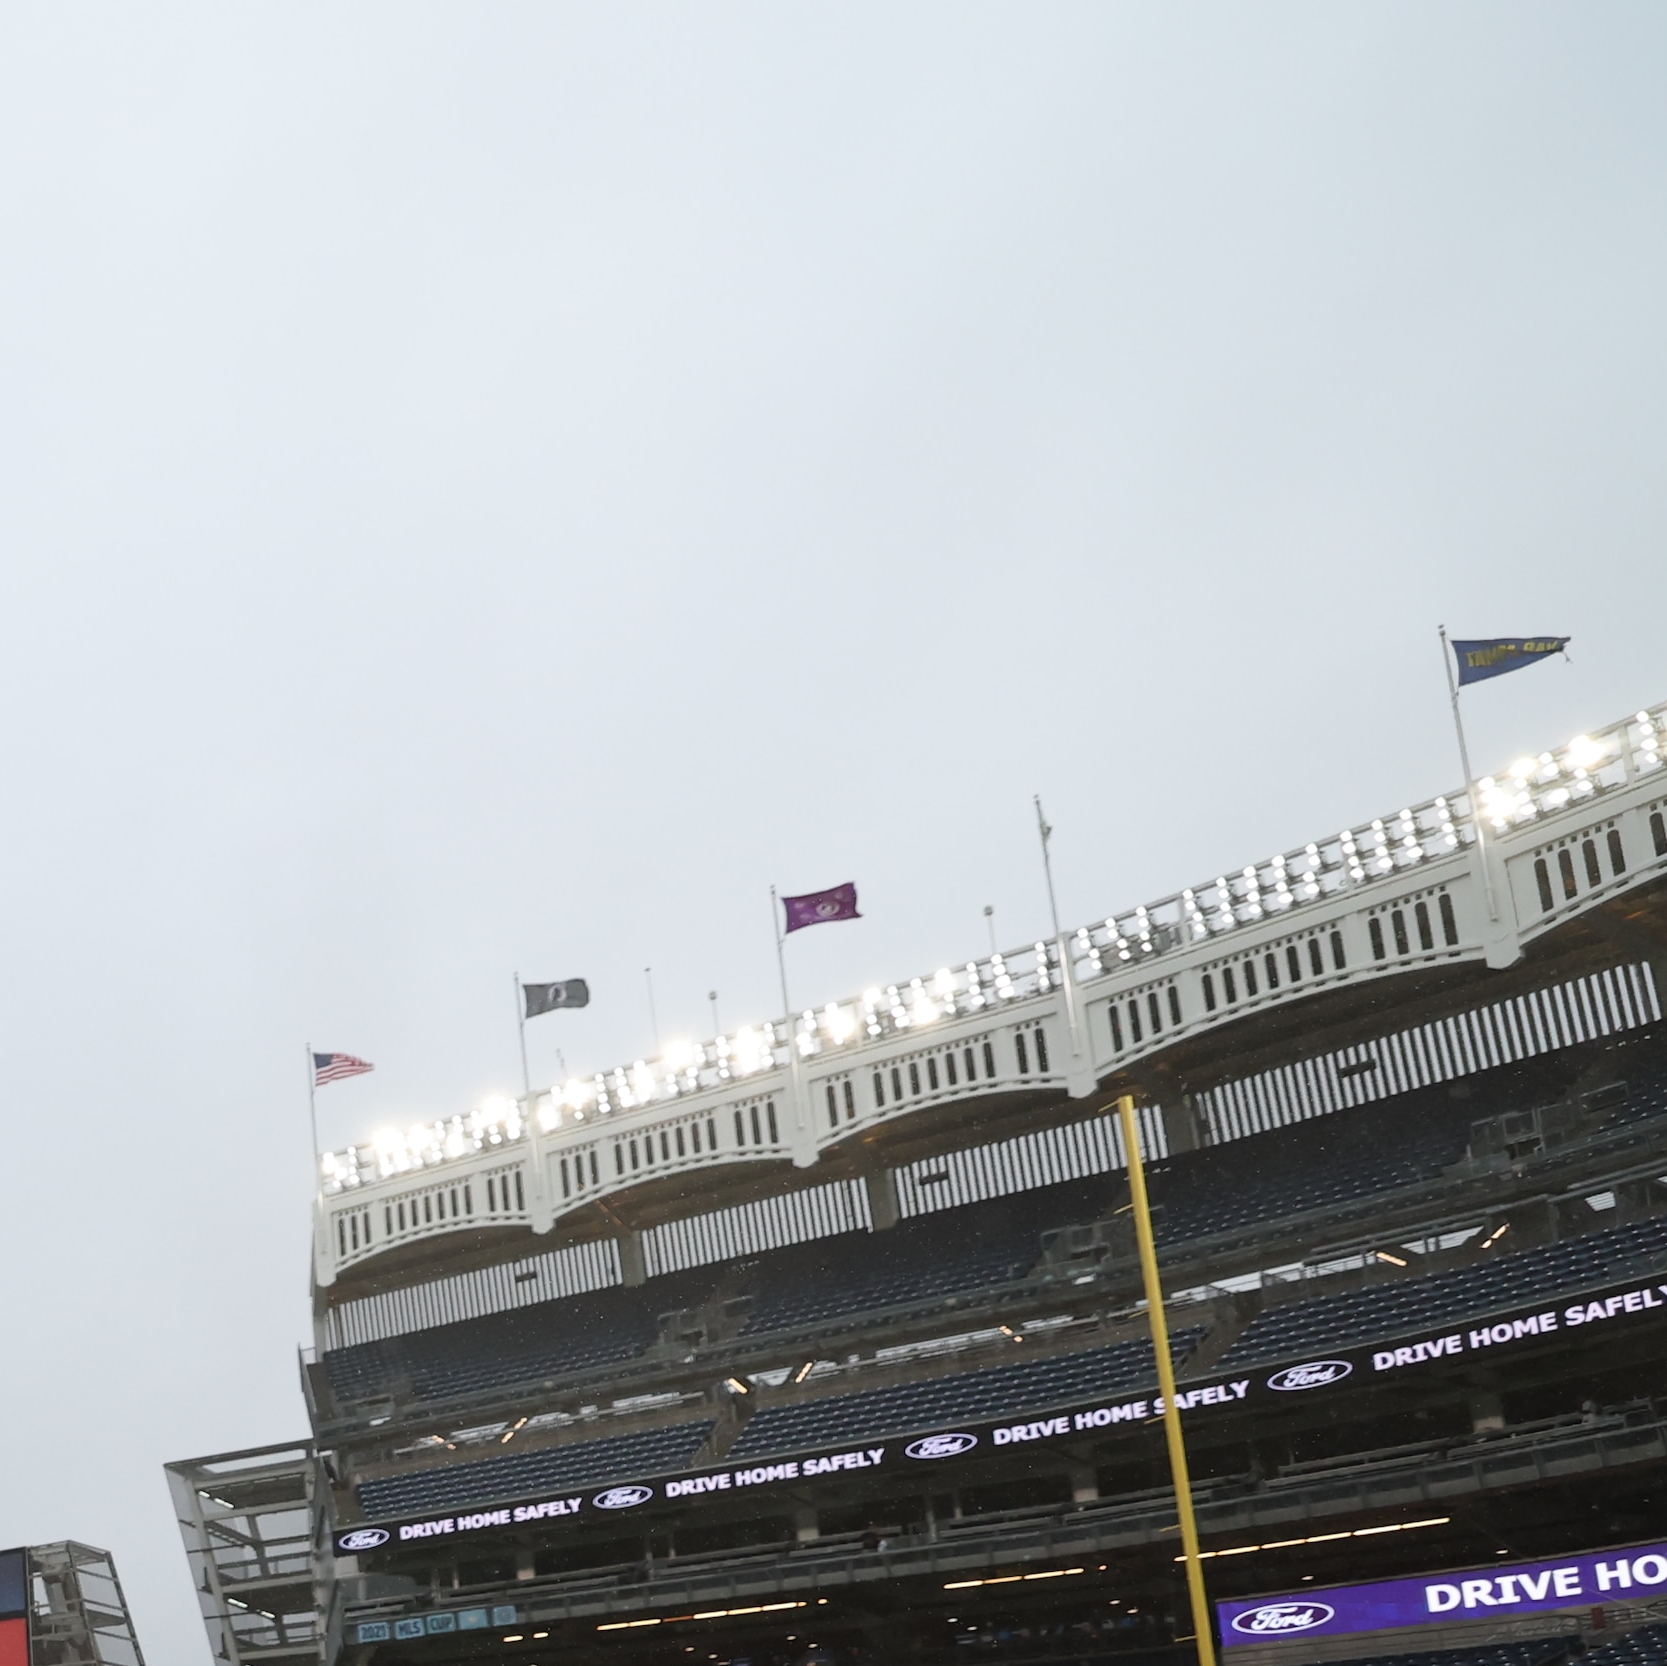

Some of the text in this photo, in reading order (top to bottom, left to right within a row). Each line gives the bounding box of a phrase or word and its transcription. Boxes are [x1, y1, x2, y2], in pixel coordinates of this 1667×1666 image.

[1373, 1311, 1558, 1371] DRIVE HOME
[993, 1417, 1070, 1446] DRIVE
[1075, 1401, 1147, 1430] HOME
[665, 1447, 885, 1498] DRIVE HOME SAFELY
[400, 1498, 582, 1540] DRIVE HOME SAFELY
[1425, 1565, 1582, 1613] DRIVE
